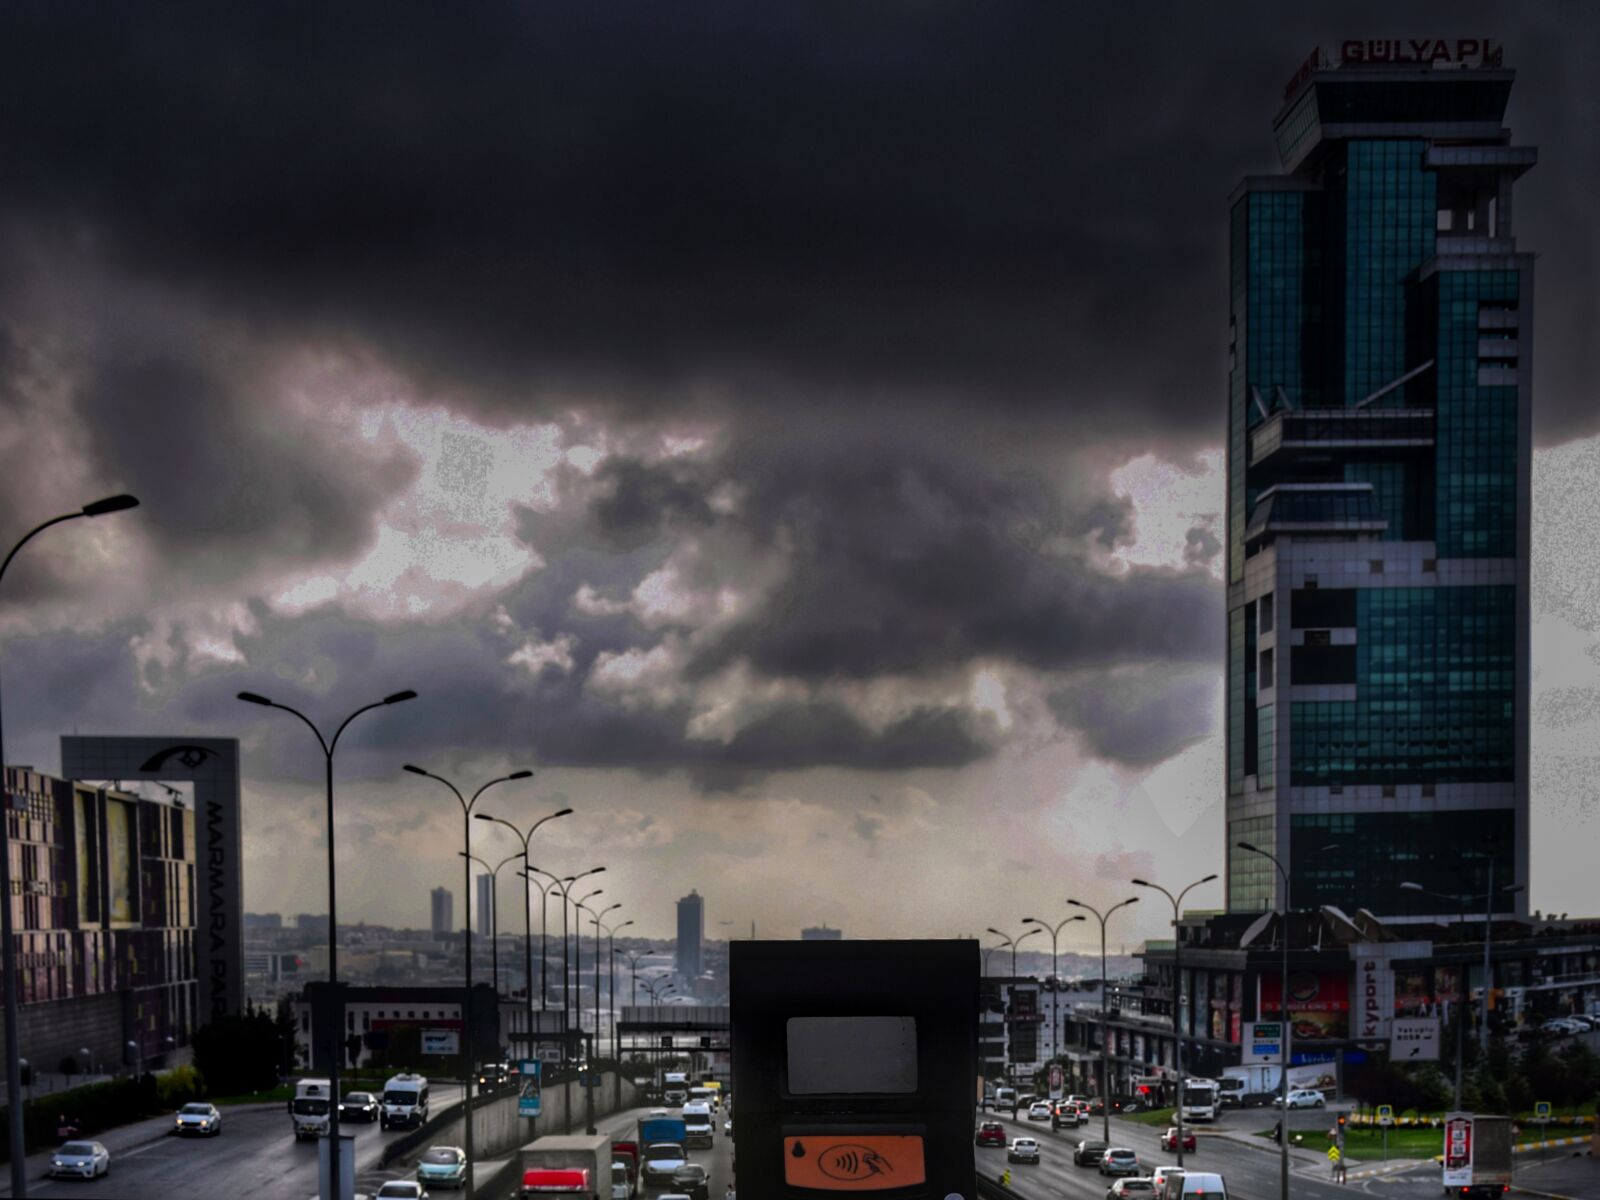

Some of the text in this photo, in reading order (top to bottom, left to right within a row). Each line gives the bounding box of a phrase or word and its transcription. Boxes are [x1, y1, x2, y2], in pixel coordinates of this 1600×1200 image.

[1341, 39, 1490, 63] GÜLYAPI
[206, 800, 228, 1024] MARMARA PAR
